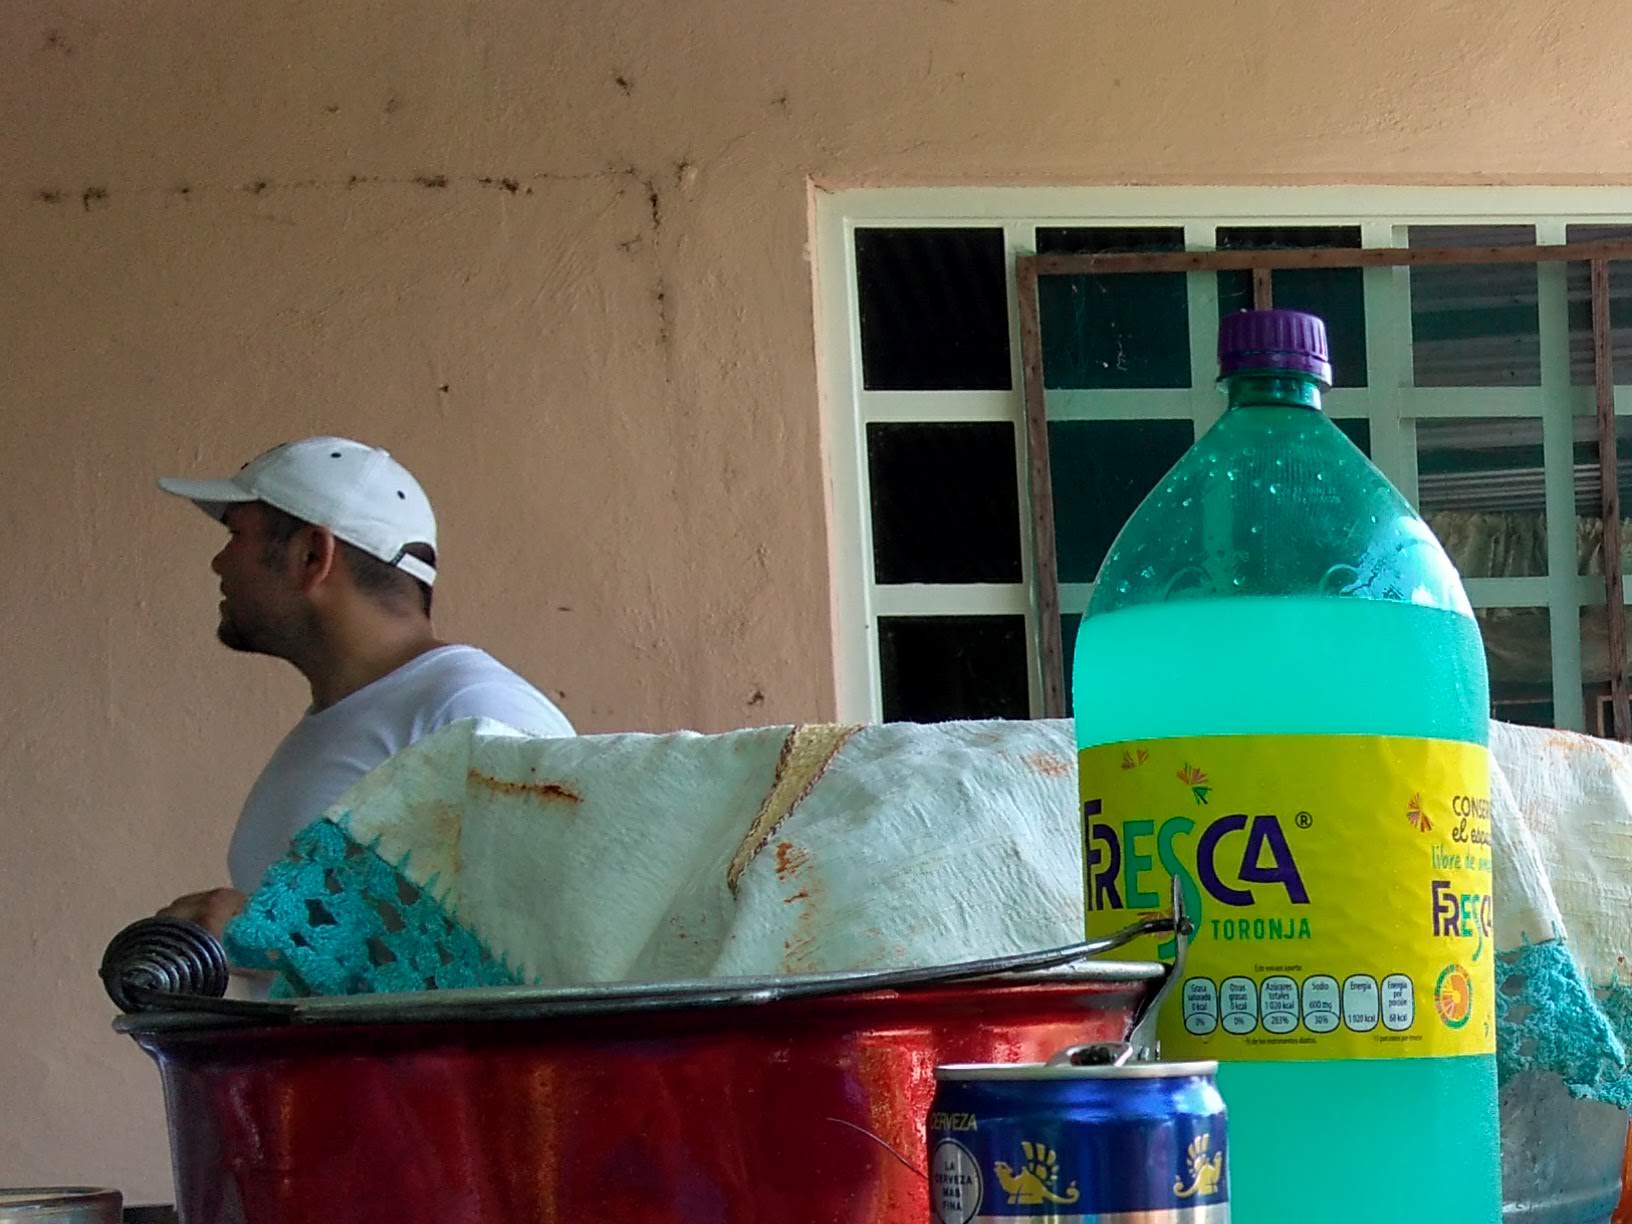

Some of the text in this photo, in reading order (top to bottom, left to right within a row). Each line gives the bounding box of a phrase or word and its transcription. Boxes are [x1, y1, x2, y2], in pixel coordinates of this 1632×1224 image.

[1452, 817, 1468, 843] el
[1084, 799, 1311, 959] FRESCA
[1211, 918, 1311, 940] TORONJA
[945, 1161, 954, 1171] LA
